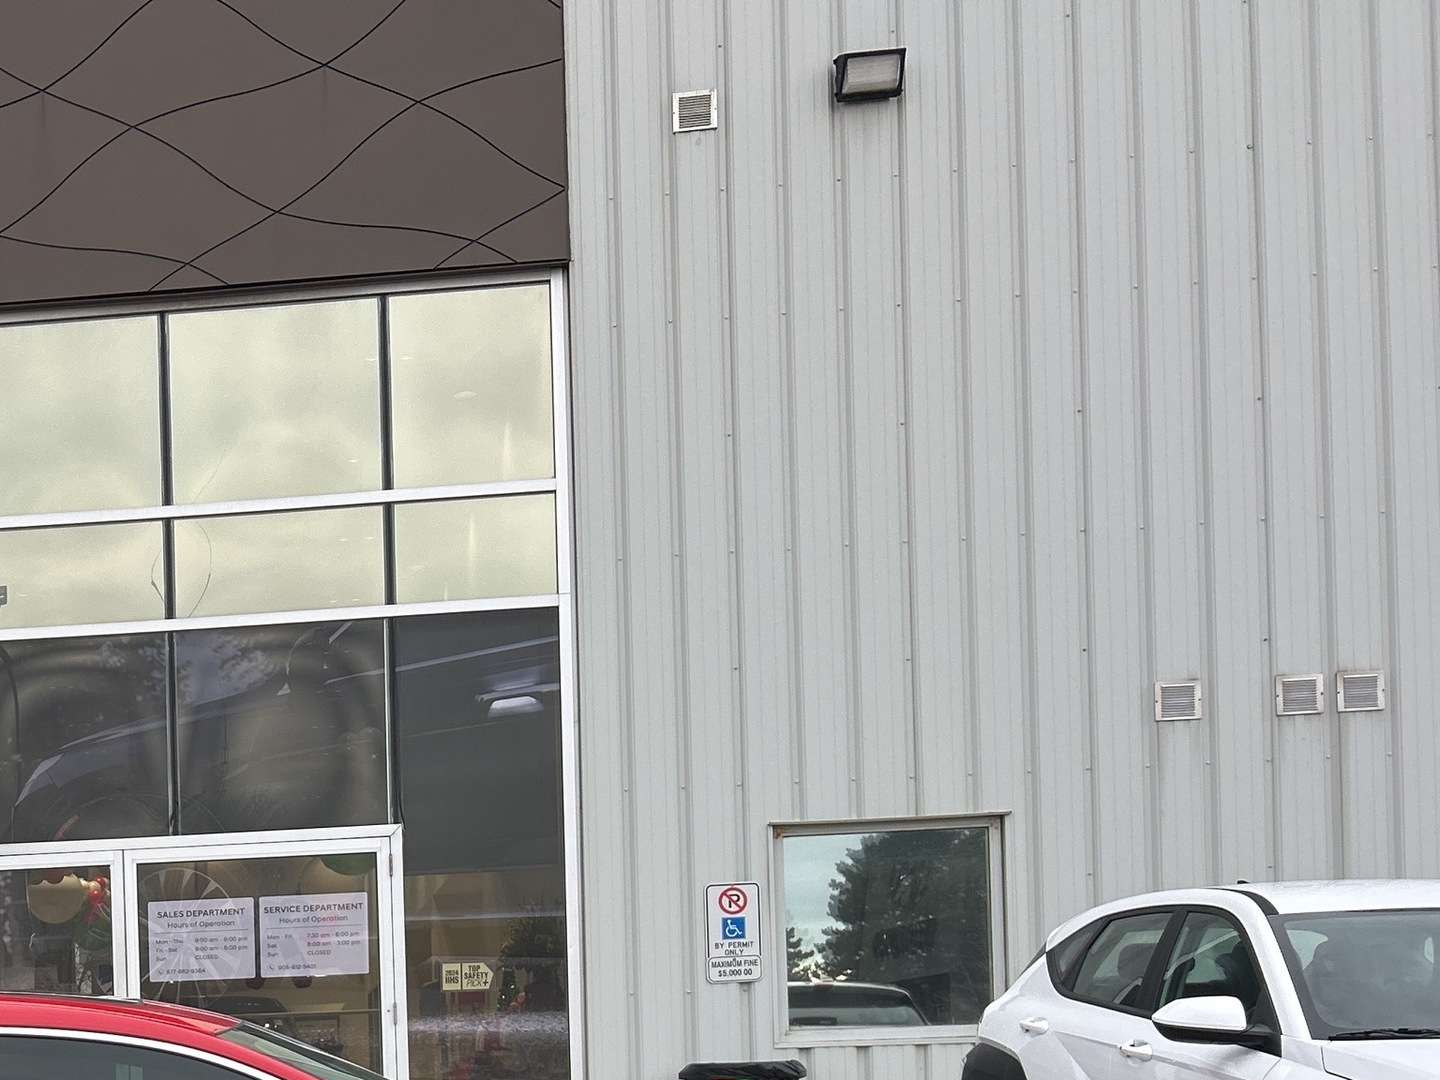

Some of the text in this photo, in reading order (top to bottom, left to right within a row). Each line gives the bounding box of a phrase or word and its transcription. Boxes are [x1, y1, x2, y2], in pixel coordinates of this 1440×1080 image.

[263, 902, 364, 914] SERVICE DEPARTMENT
[156, 908, 245, 919] SALES DEPARTMENT
[311, 915, 349, 924] Operation
[199, 920, 236, 929] Operation
[714, 941, 754, 950] BY PERMIT
[724, 948, 744, 956] ONLY
[711, 958, 759, 969] MAXIMUM FINE
